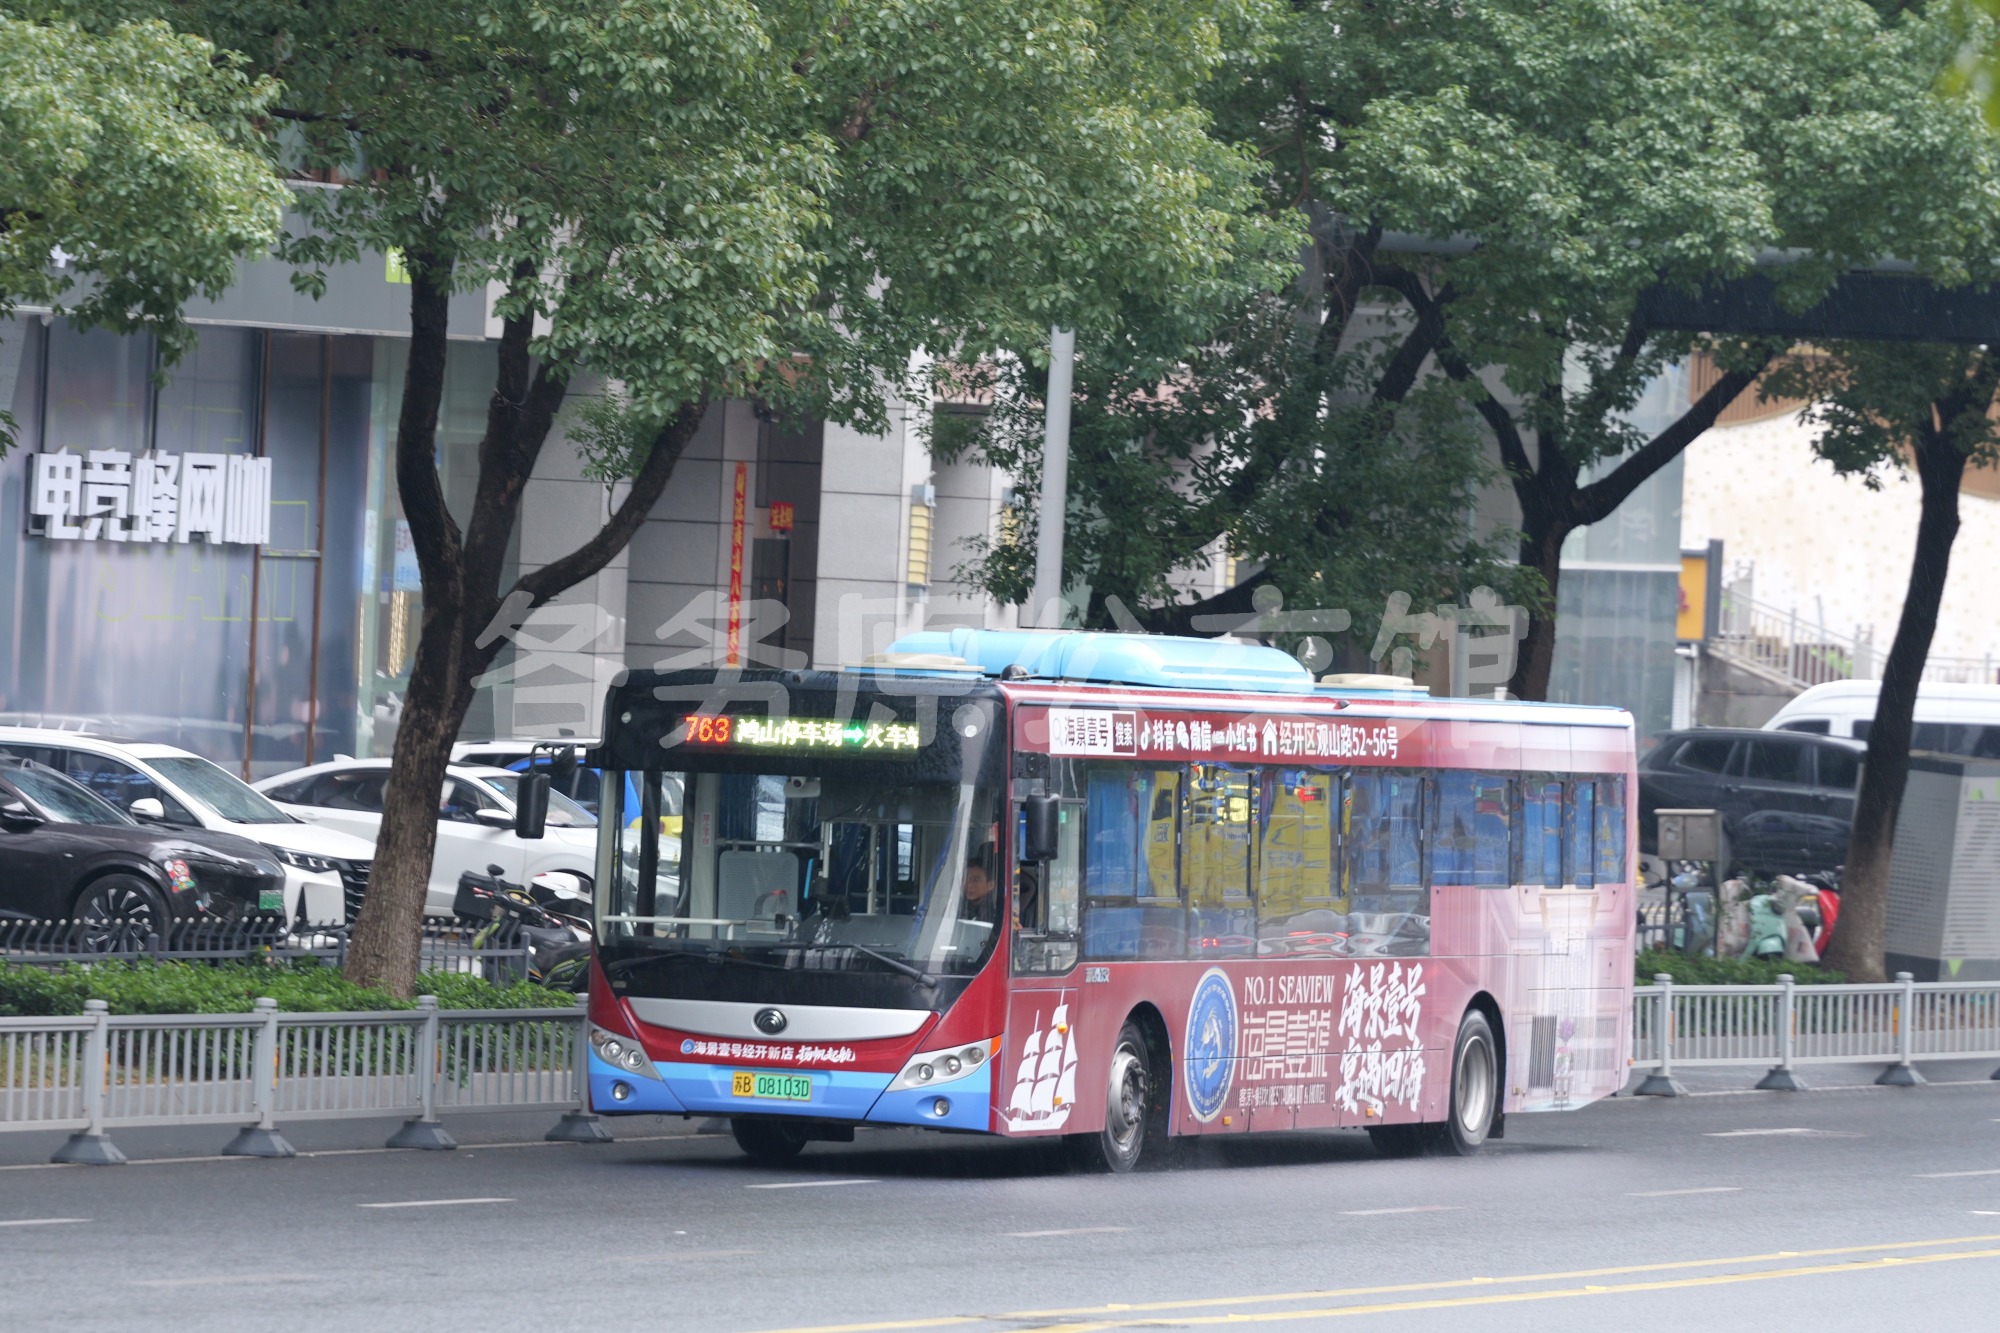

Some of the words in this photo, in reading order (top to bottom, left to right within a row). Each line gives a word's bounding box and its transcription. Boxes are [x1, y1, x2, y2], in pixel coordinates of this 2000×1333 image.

[30, 446, 272, 544] 电竞蜂网咖
[684, 716, 731, 744] 763
[736, 718, 843, 747] 鸿山停车场
[1064, 715, 1109, 748] 海景壹号
[1115, 721, 1135, 747] 搜索
[1152, 719, 1175, 751] 抖音
[1189, 720, 1212, 752] 微信
[1226, 721, 1257, 753] 小红书
[1279, 720, 1399, 759] 经开区观山路52~56号
[1244, 976, 1274, 1005] NO.1
[1278, 975, 1335, 1004] SEAVIEW
[1338, 961, 1426, 1041] 海景壹号
[694, 1041, 794, 1061] 海景壹号经开新店
[795, 1045, 857, 1065] 扬帆起航
[1335, 1034, 1426, 1118] 宴遇四海
